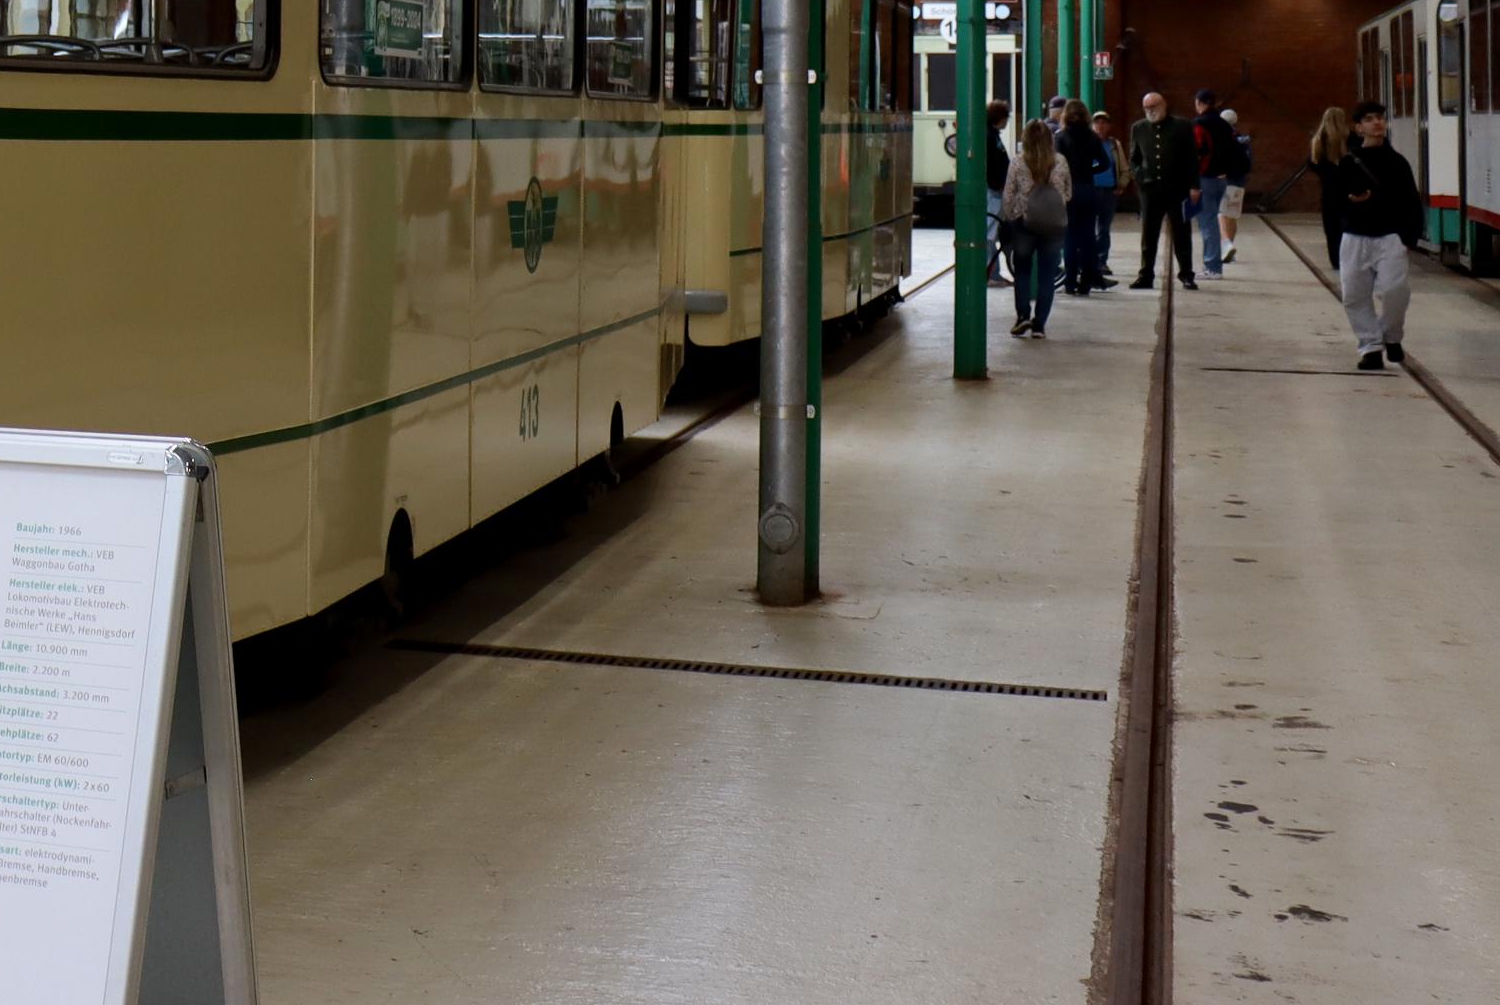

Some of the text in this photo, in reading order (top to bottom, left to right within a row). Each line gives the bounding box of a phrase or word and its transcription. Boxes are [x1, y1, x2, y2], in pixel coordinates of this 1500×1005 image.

[519, 384, 539, 442] 413
[15, 523, 82, 537] Baujahr: 1966
[13, 543, 61, 555] Hersteller
[96, 549, 115, 560] VEB
[11, 557, 95, 573] Waggonbau Gotha
[8, 579, 56, 590] Hersteller
[86, 584, 105, 595] VEB
[7, 592, 72, 605] Lokomotivbau
[5, 605, 36, 617] nische
[37, 608, 67, 620] Werke
[77, 626, 136, 639] Hennigsdorf
[0, 641, 88, 657] Länge: 10.900 mm
[32, 665, 60, 677] 2.200
[63, 690, 90, 701] 3.200
[91, 695, 110, 704] mm
[46, 710, 59, 721] 22
[46, 732, 60, 743] 62
[37, 753, 52, 764] EM
[54, 756, 89, 767] 60/600
[53, 778, 81, 790] (kW):
[52, 814, 112, 828] (Nockenfahr-
[24, 849, 94, 864] elektrodynami-
[37, 864, 100, 881] Handbremse,
